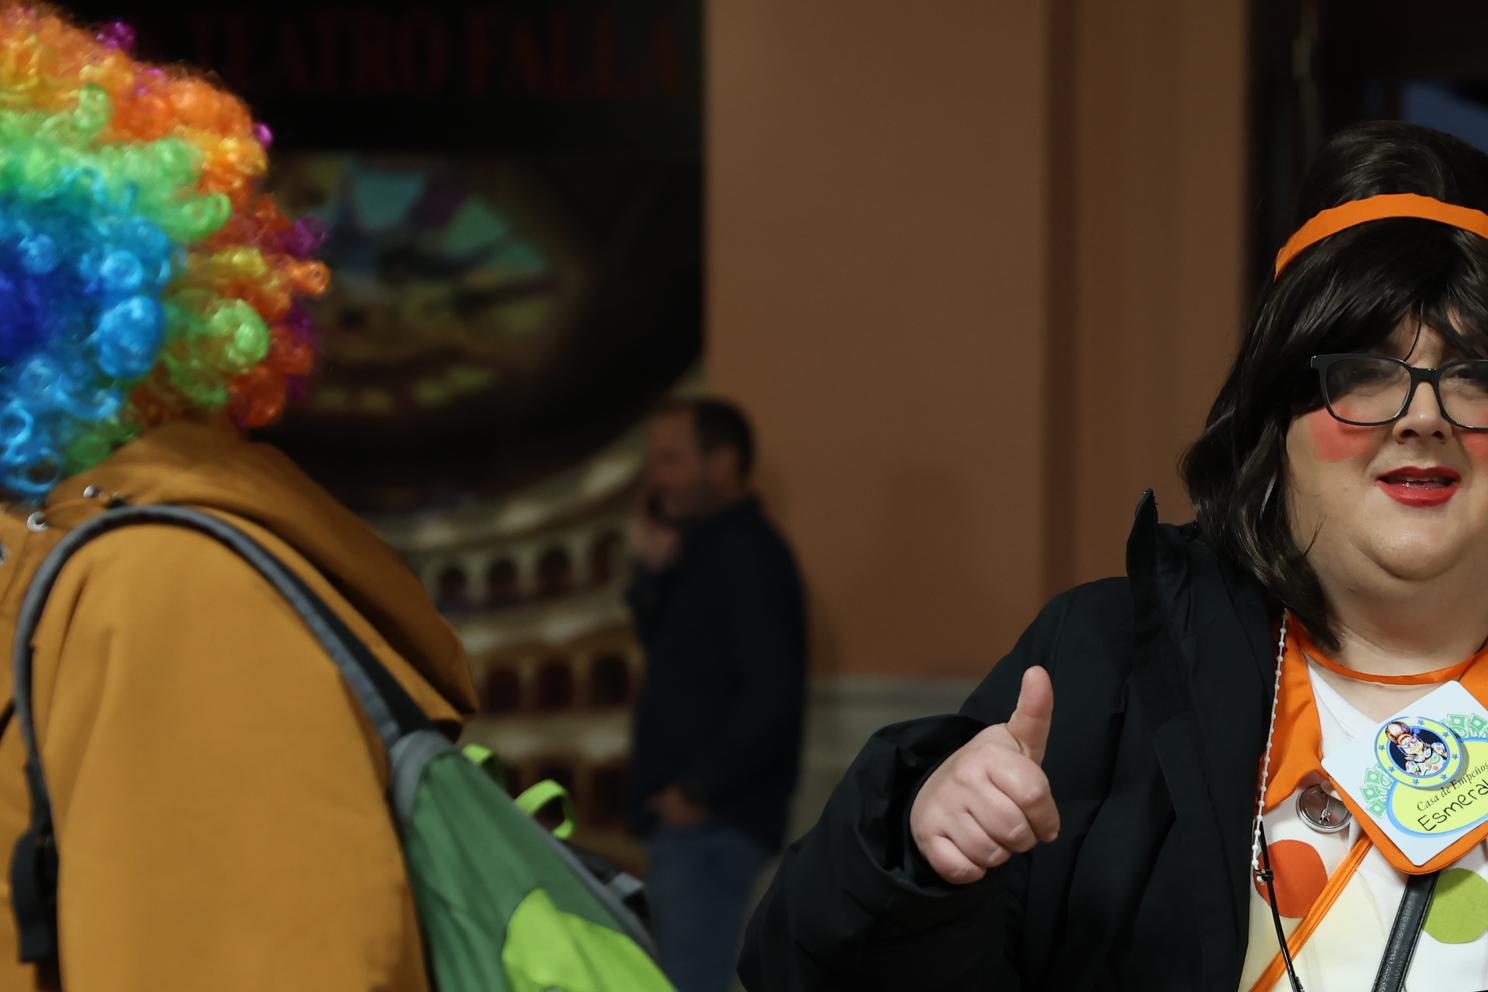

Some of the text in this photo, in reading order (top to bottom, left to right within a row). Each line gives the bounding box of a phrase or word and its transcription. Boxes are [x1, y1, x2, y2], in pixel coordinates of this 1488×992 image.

[187, 8, 683, 98] TEATRO FALLA
[1417, 762, 1488, 812] Casa de Empeños
